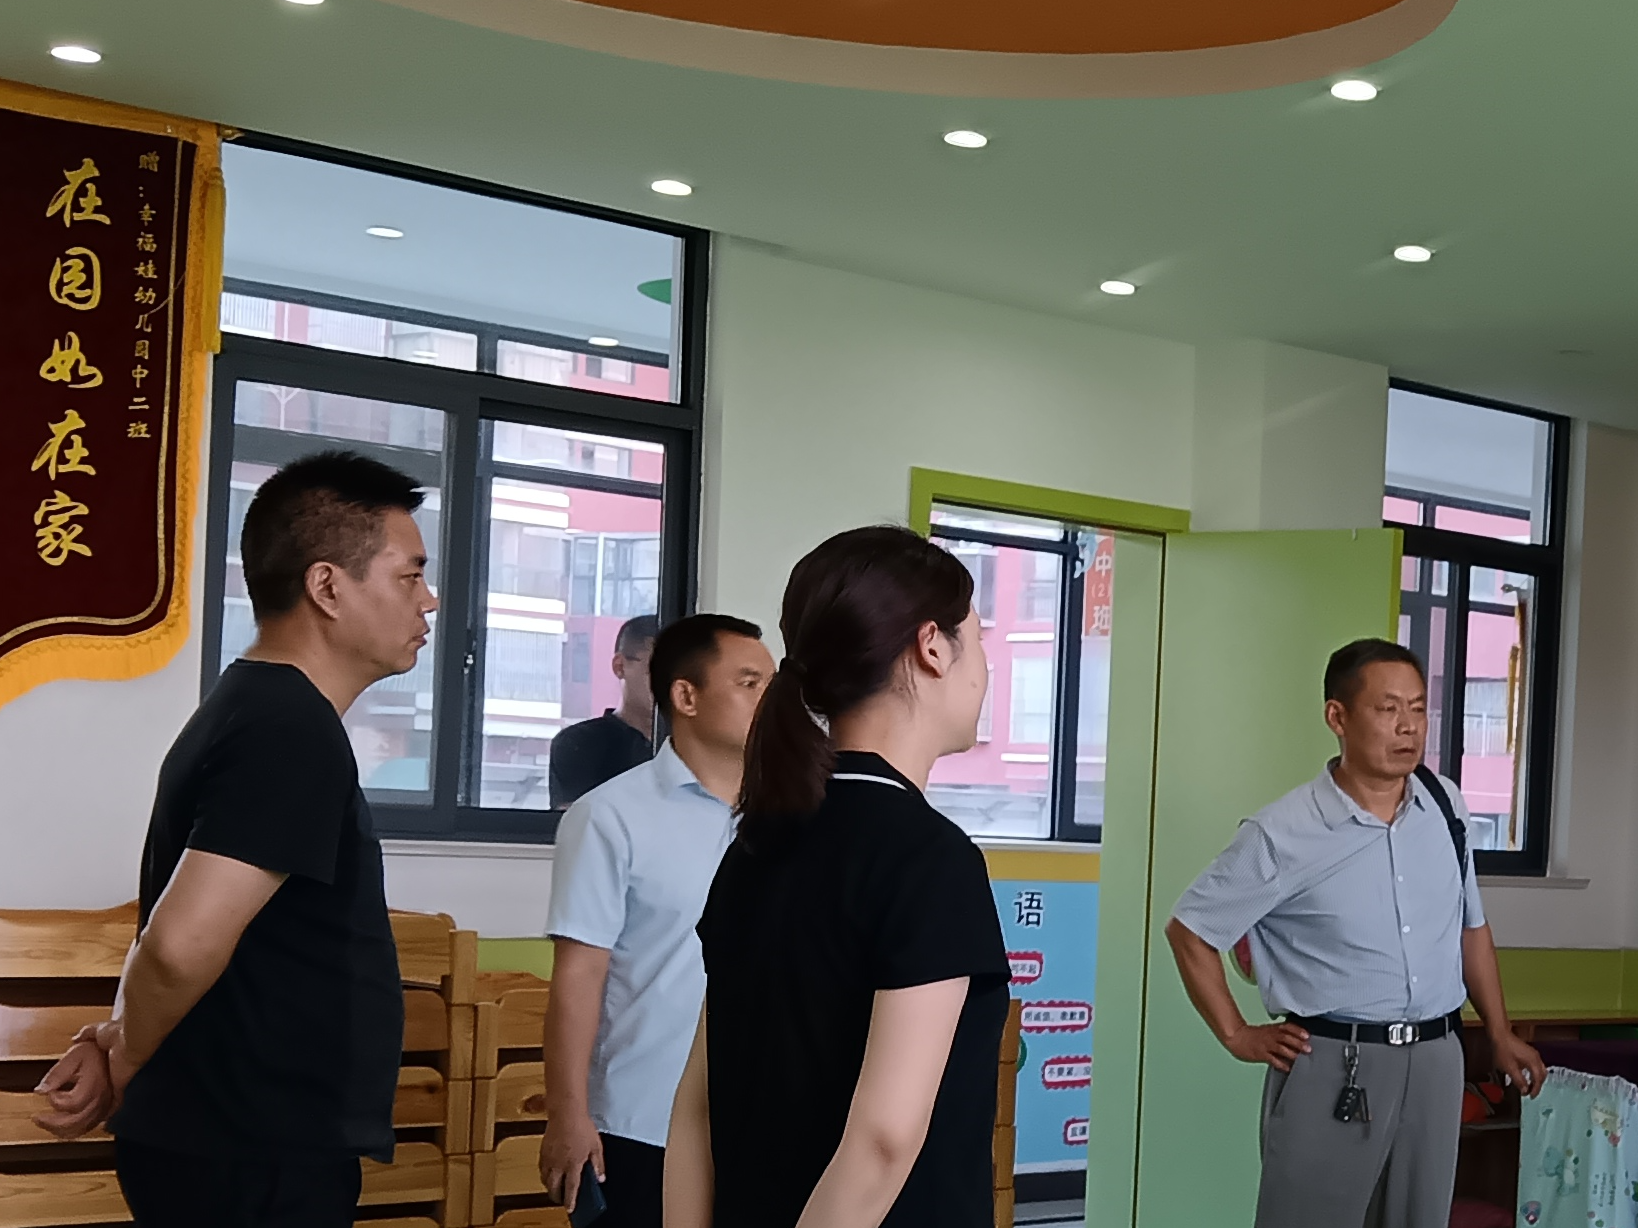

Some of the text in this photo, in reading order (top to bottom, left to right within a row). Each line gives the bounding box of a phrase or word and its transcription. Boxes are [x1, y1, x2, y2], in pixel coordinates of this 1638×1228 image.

[31, 157, 111, 566] 在园如在家
[1014, 889, 1043, 928] 语
